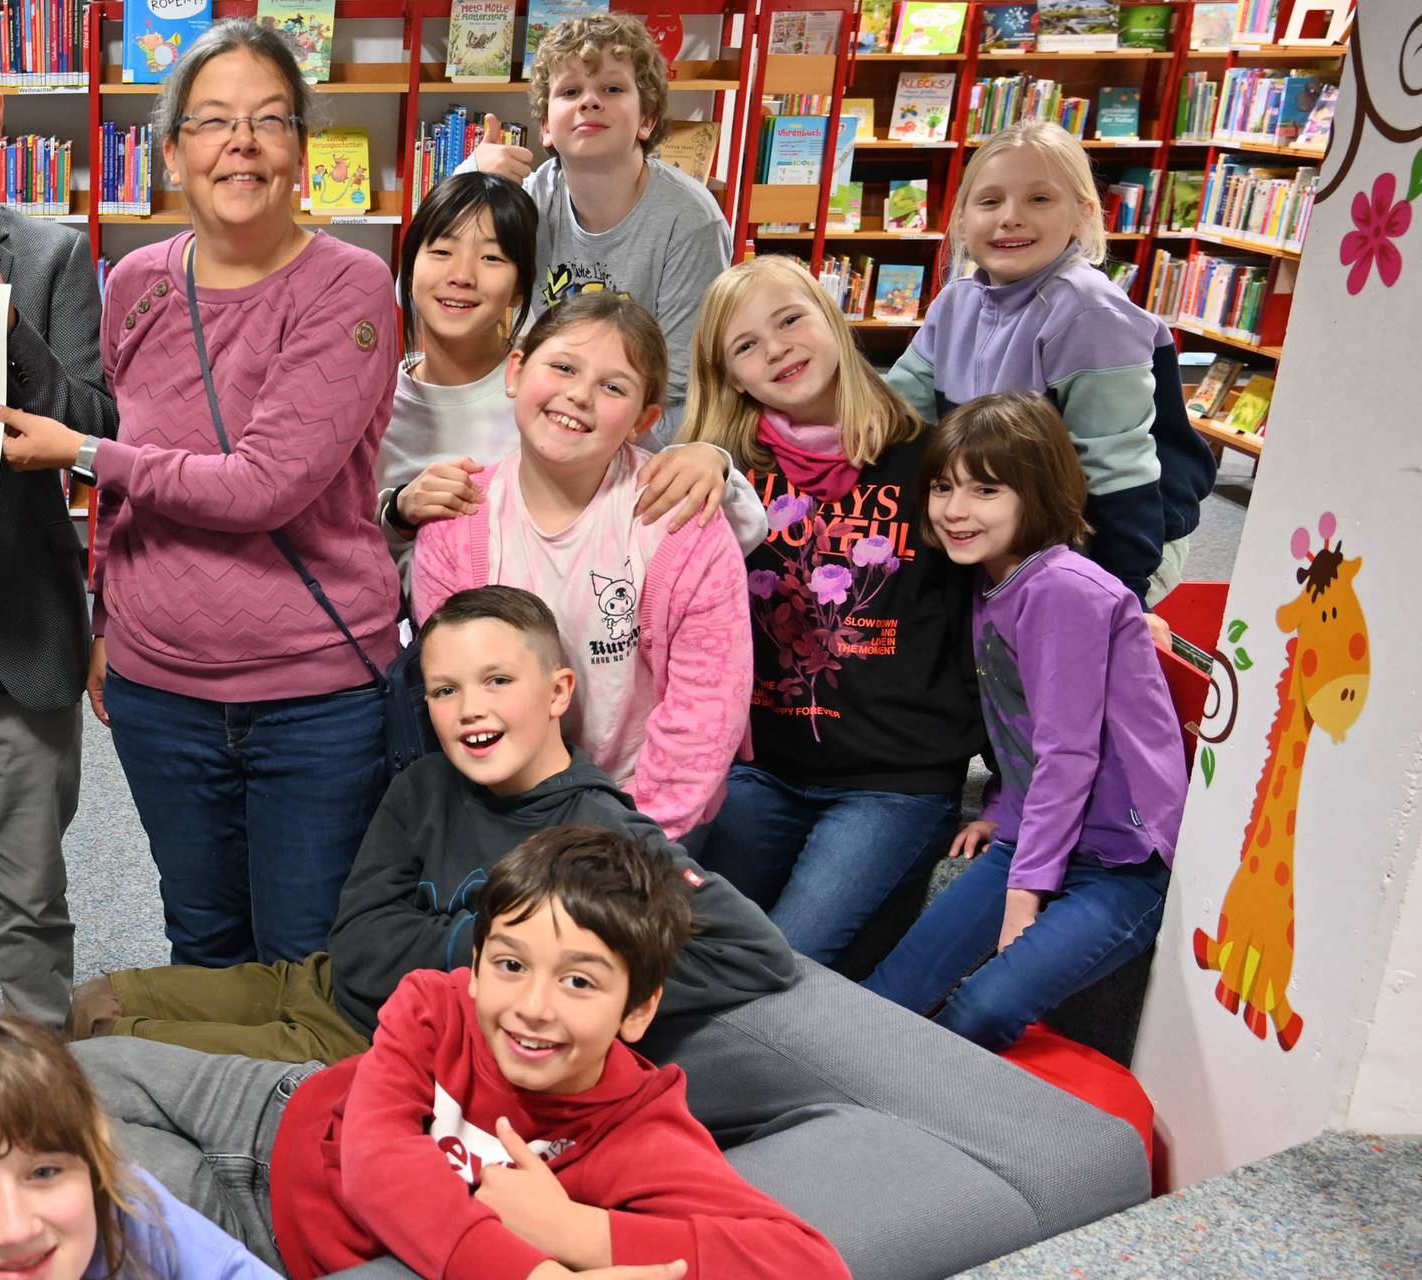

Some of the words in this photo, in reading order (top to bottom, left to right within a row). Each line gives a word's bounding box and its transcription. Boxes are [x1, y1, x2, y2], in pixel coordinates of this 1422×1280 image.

[844, 616, 876, 628] SLOW
[876, 619, 898, 628] DOWN
[881, 628, 896, 637] AND
[871, 637, 886, 646] LIVE
[887, 638, 895, 646] IN
[837, 642, 859, 653] THE
[858, 645, 896, 656] MOMENT
